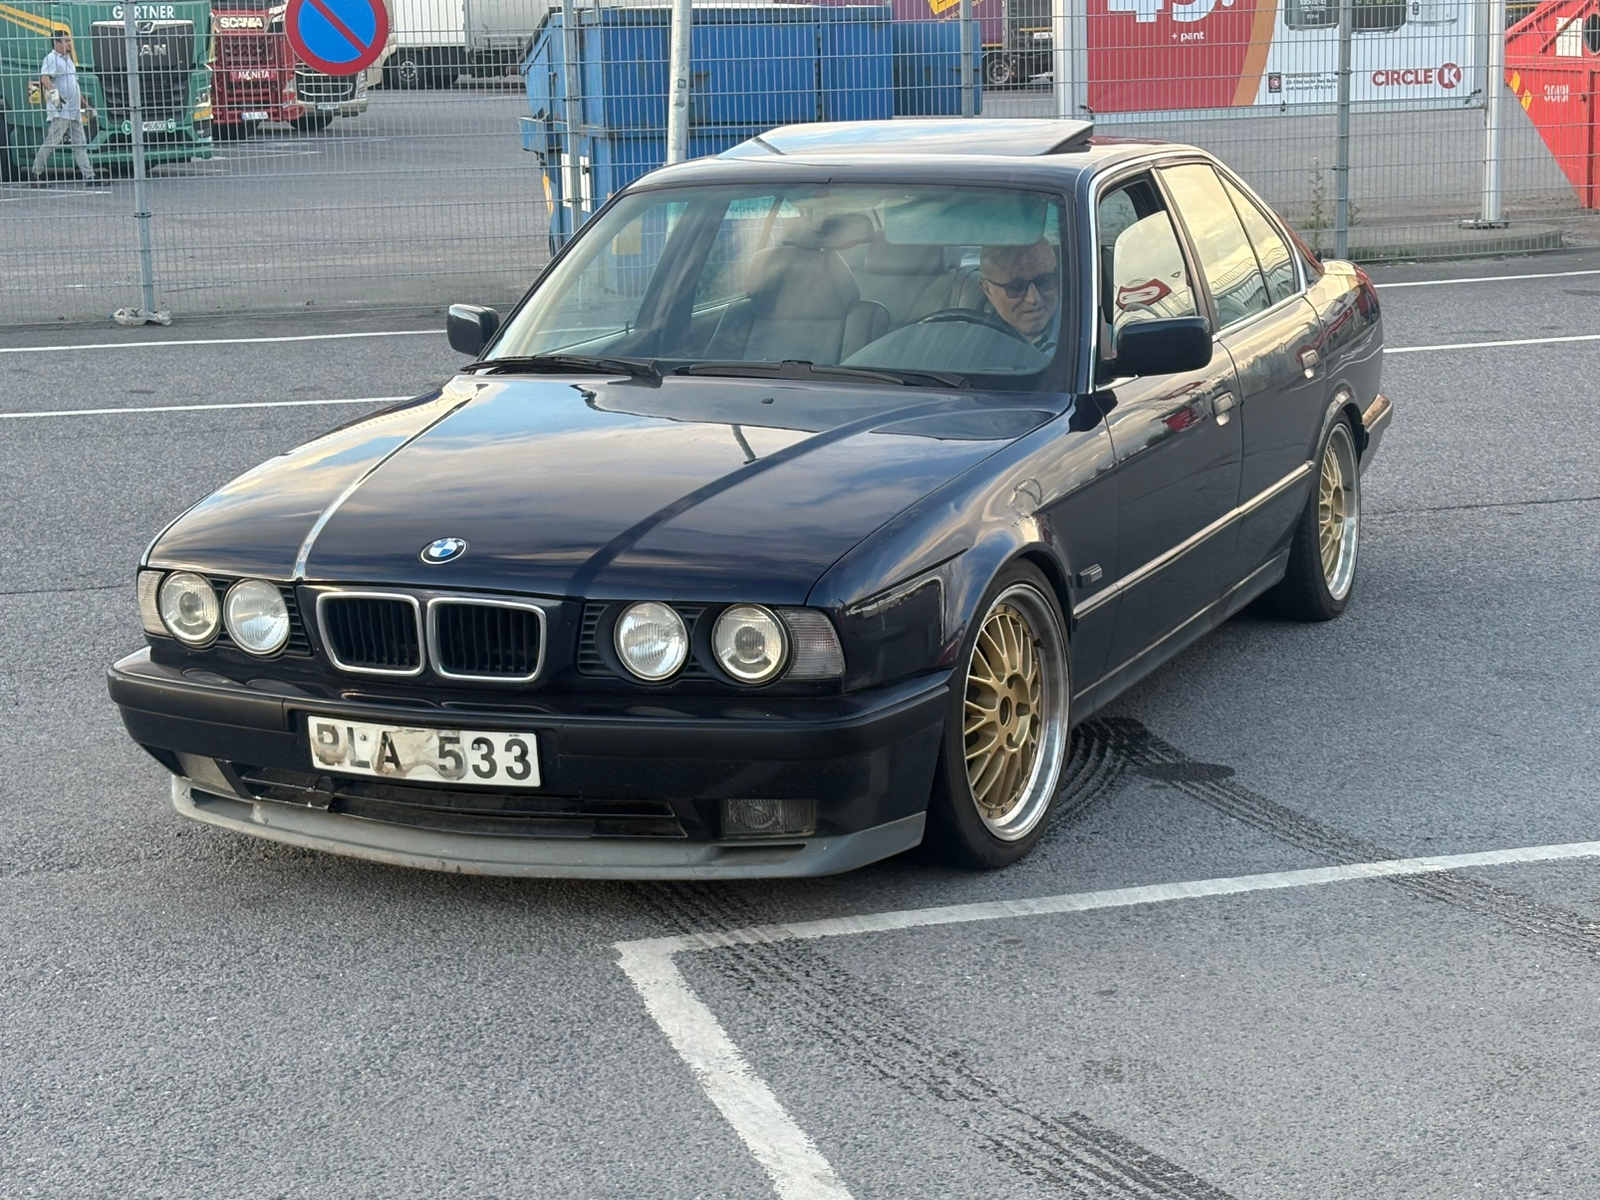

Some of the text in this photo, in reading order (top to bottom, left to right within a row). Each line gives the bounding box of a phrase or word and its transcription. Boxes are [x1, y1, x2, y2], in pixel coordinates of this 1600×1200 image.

[112, 5, 175, 19] GRTNER
[220, 17, 264, 28] SCANIA
[1180, 31, 1205, 42] pant
[1372, 65, 1460, 88] CIRCLE K
[438, 734, 532, 781] 533
